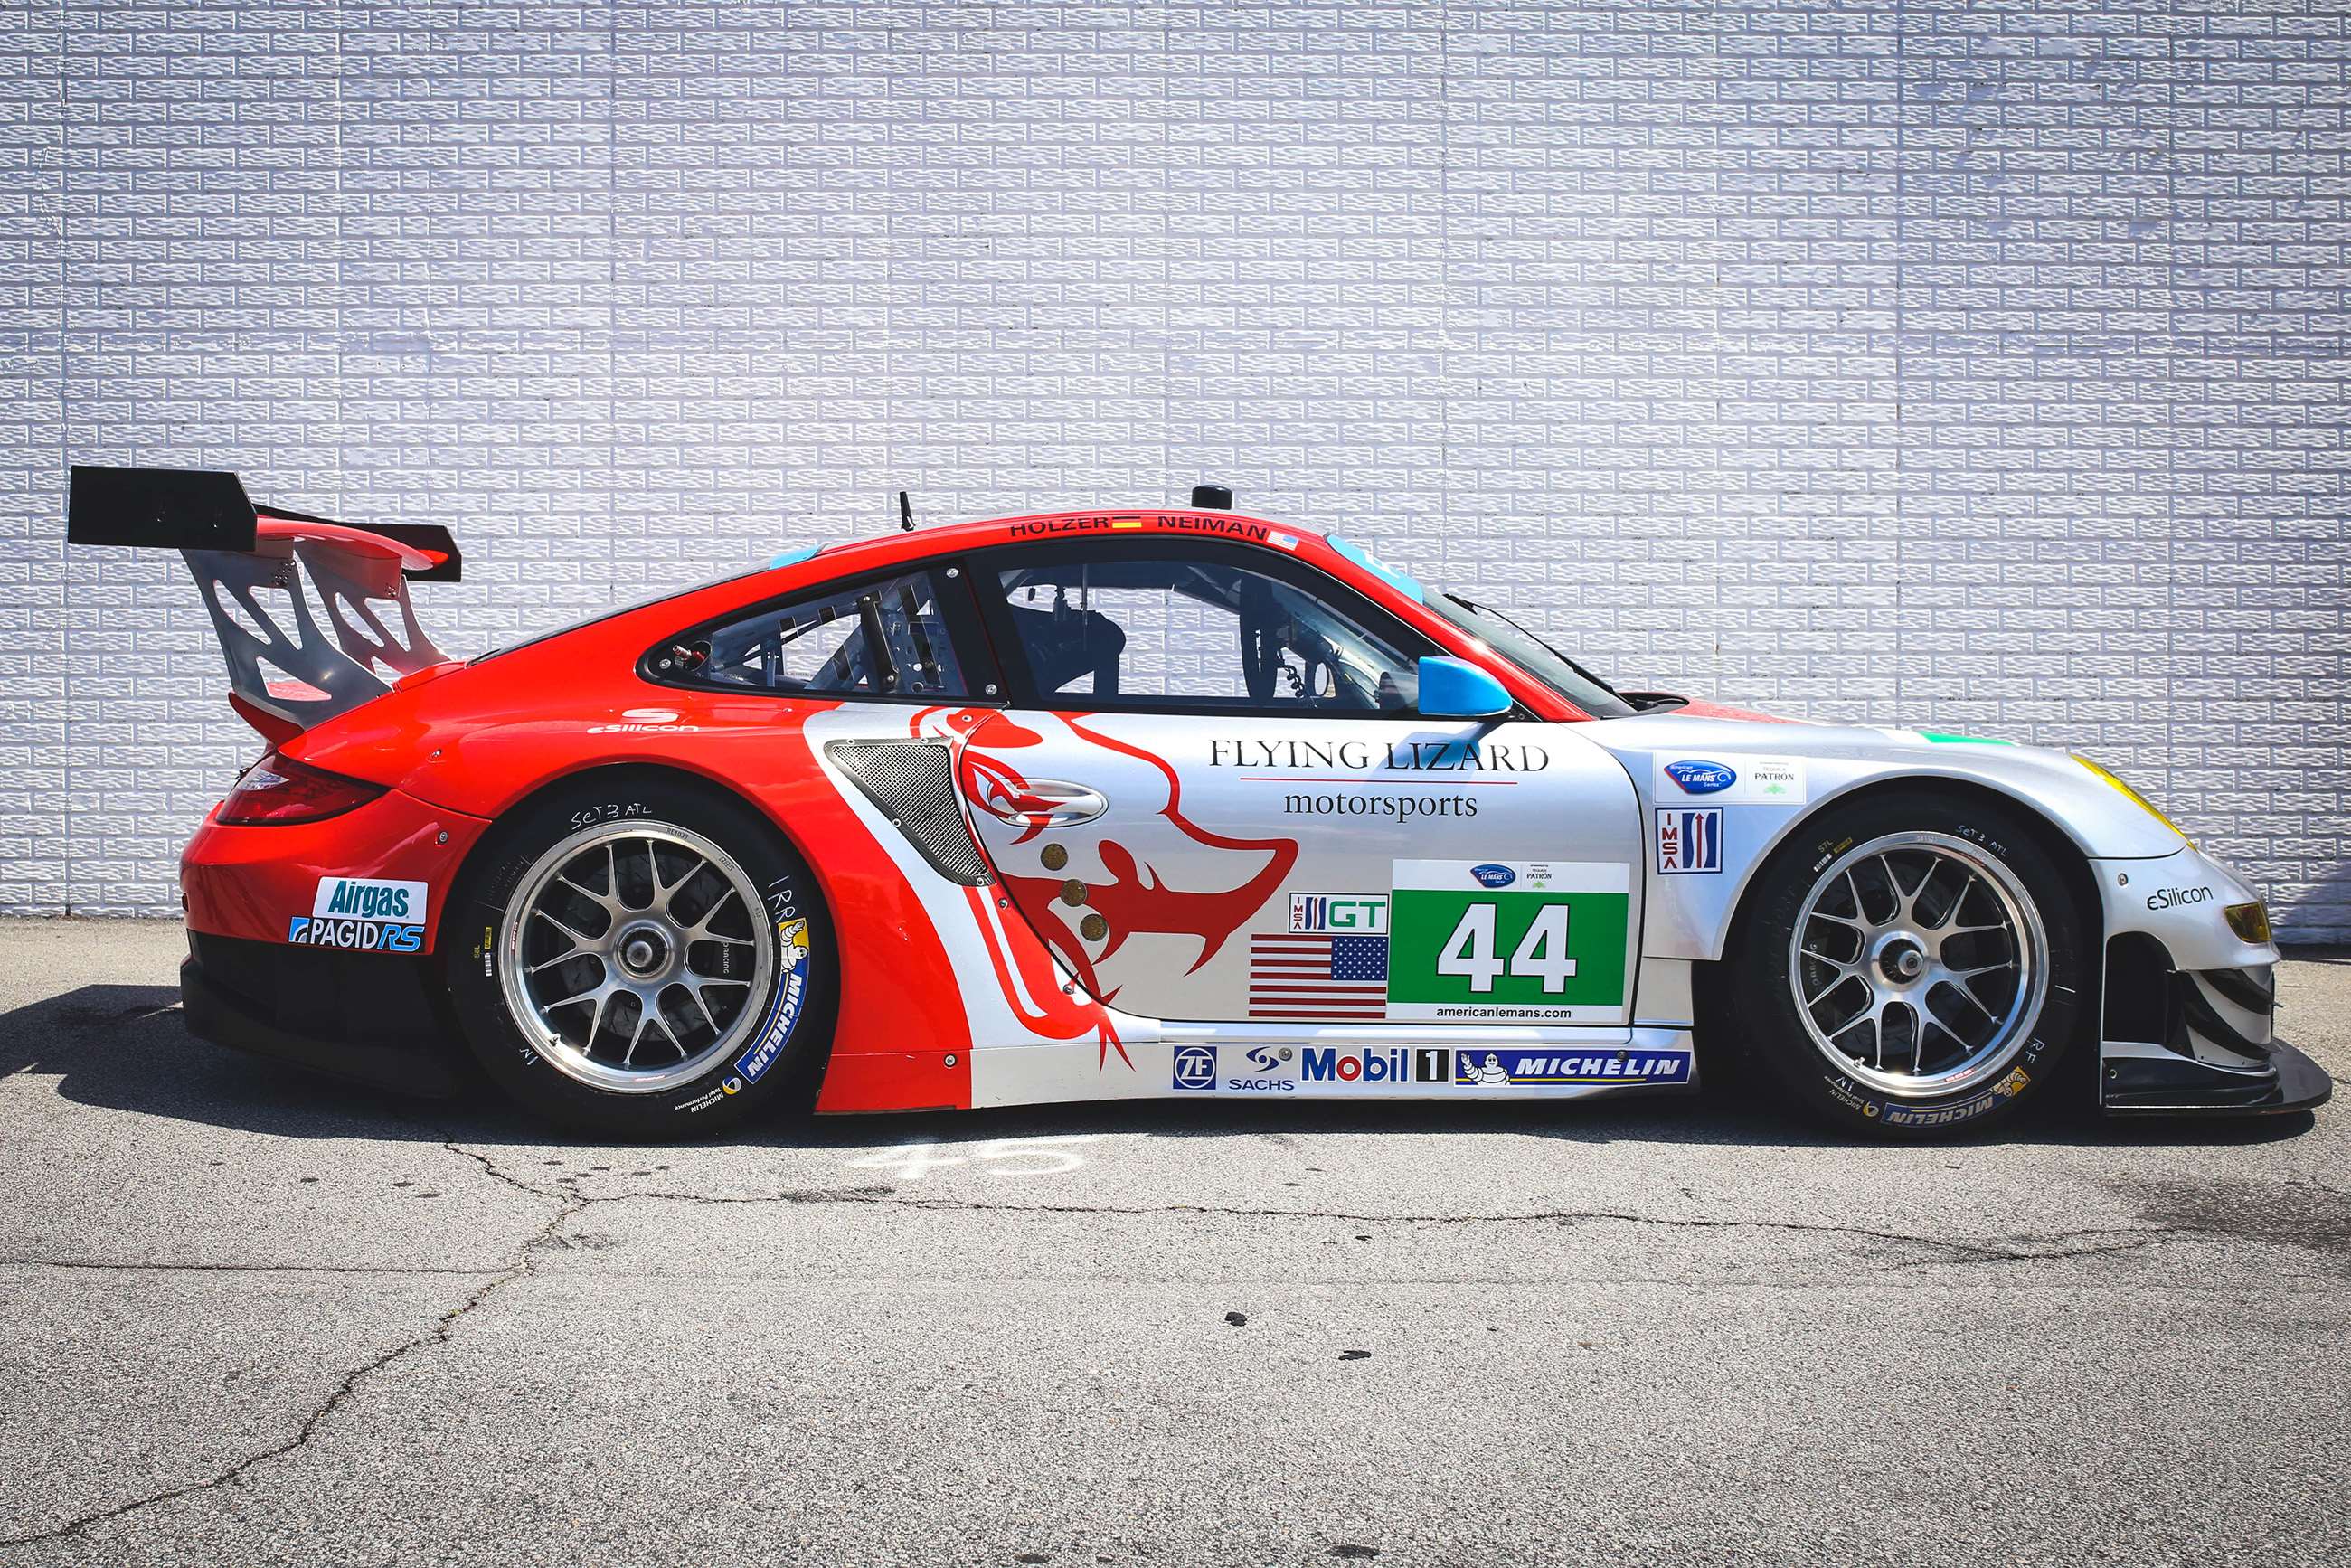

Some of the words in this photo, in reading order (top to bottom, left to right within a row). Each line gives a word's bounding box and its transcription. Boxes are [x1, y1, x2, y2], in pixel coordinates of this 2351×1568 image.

[1009, 515, 1109, 537] HOLZER
[1157, 515, 1268, 541] NEIMAN
[1207, 739, 1369, 770] FLYING
[1383, 741, 1550, 772] LIZARD
[1681, 774, 1692, 782] LE
[1693, 773, 1716, 782] MANS
[624, 802, 652, 816] ATL
[1282, 792, 1478, 824] motorsports
[1661, 813, 1678, 869] IMSA
[327, 880, 410, 919] Airgas
[2146, 885, 2214, 911] eSilicon
[1293, 896, 1303, 930] IMSA
[1328, 900, 1387, 928] GT
[1435, 902, 1579, 995] 44
[747, 972, 803, 1078] MICHELIN
[1435, 1005, 1572, 1020] americanlemans.com
[1178, 1054, 1213, 1080] ZF
[1300, 1046, 1409, 1082] Mobil
[1424, 1049, 1440, 1082] 1
[1514, 1057, 1682, 1076] MICHELIN
[708, 1087, 722, 1098] Total
[1228, 1078, 1295, 1091] SACHS
[691, 1091, 724, 1113] MICHELIN
[1887, 1095, 1995, 1125] MICHELIN
